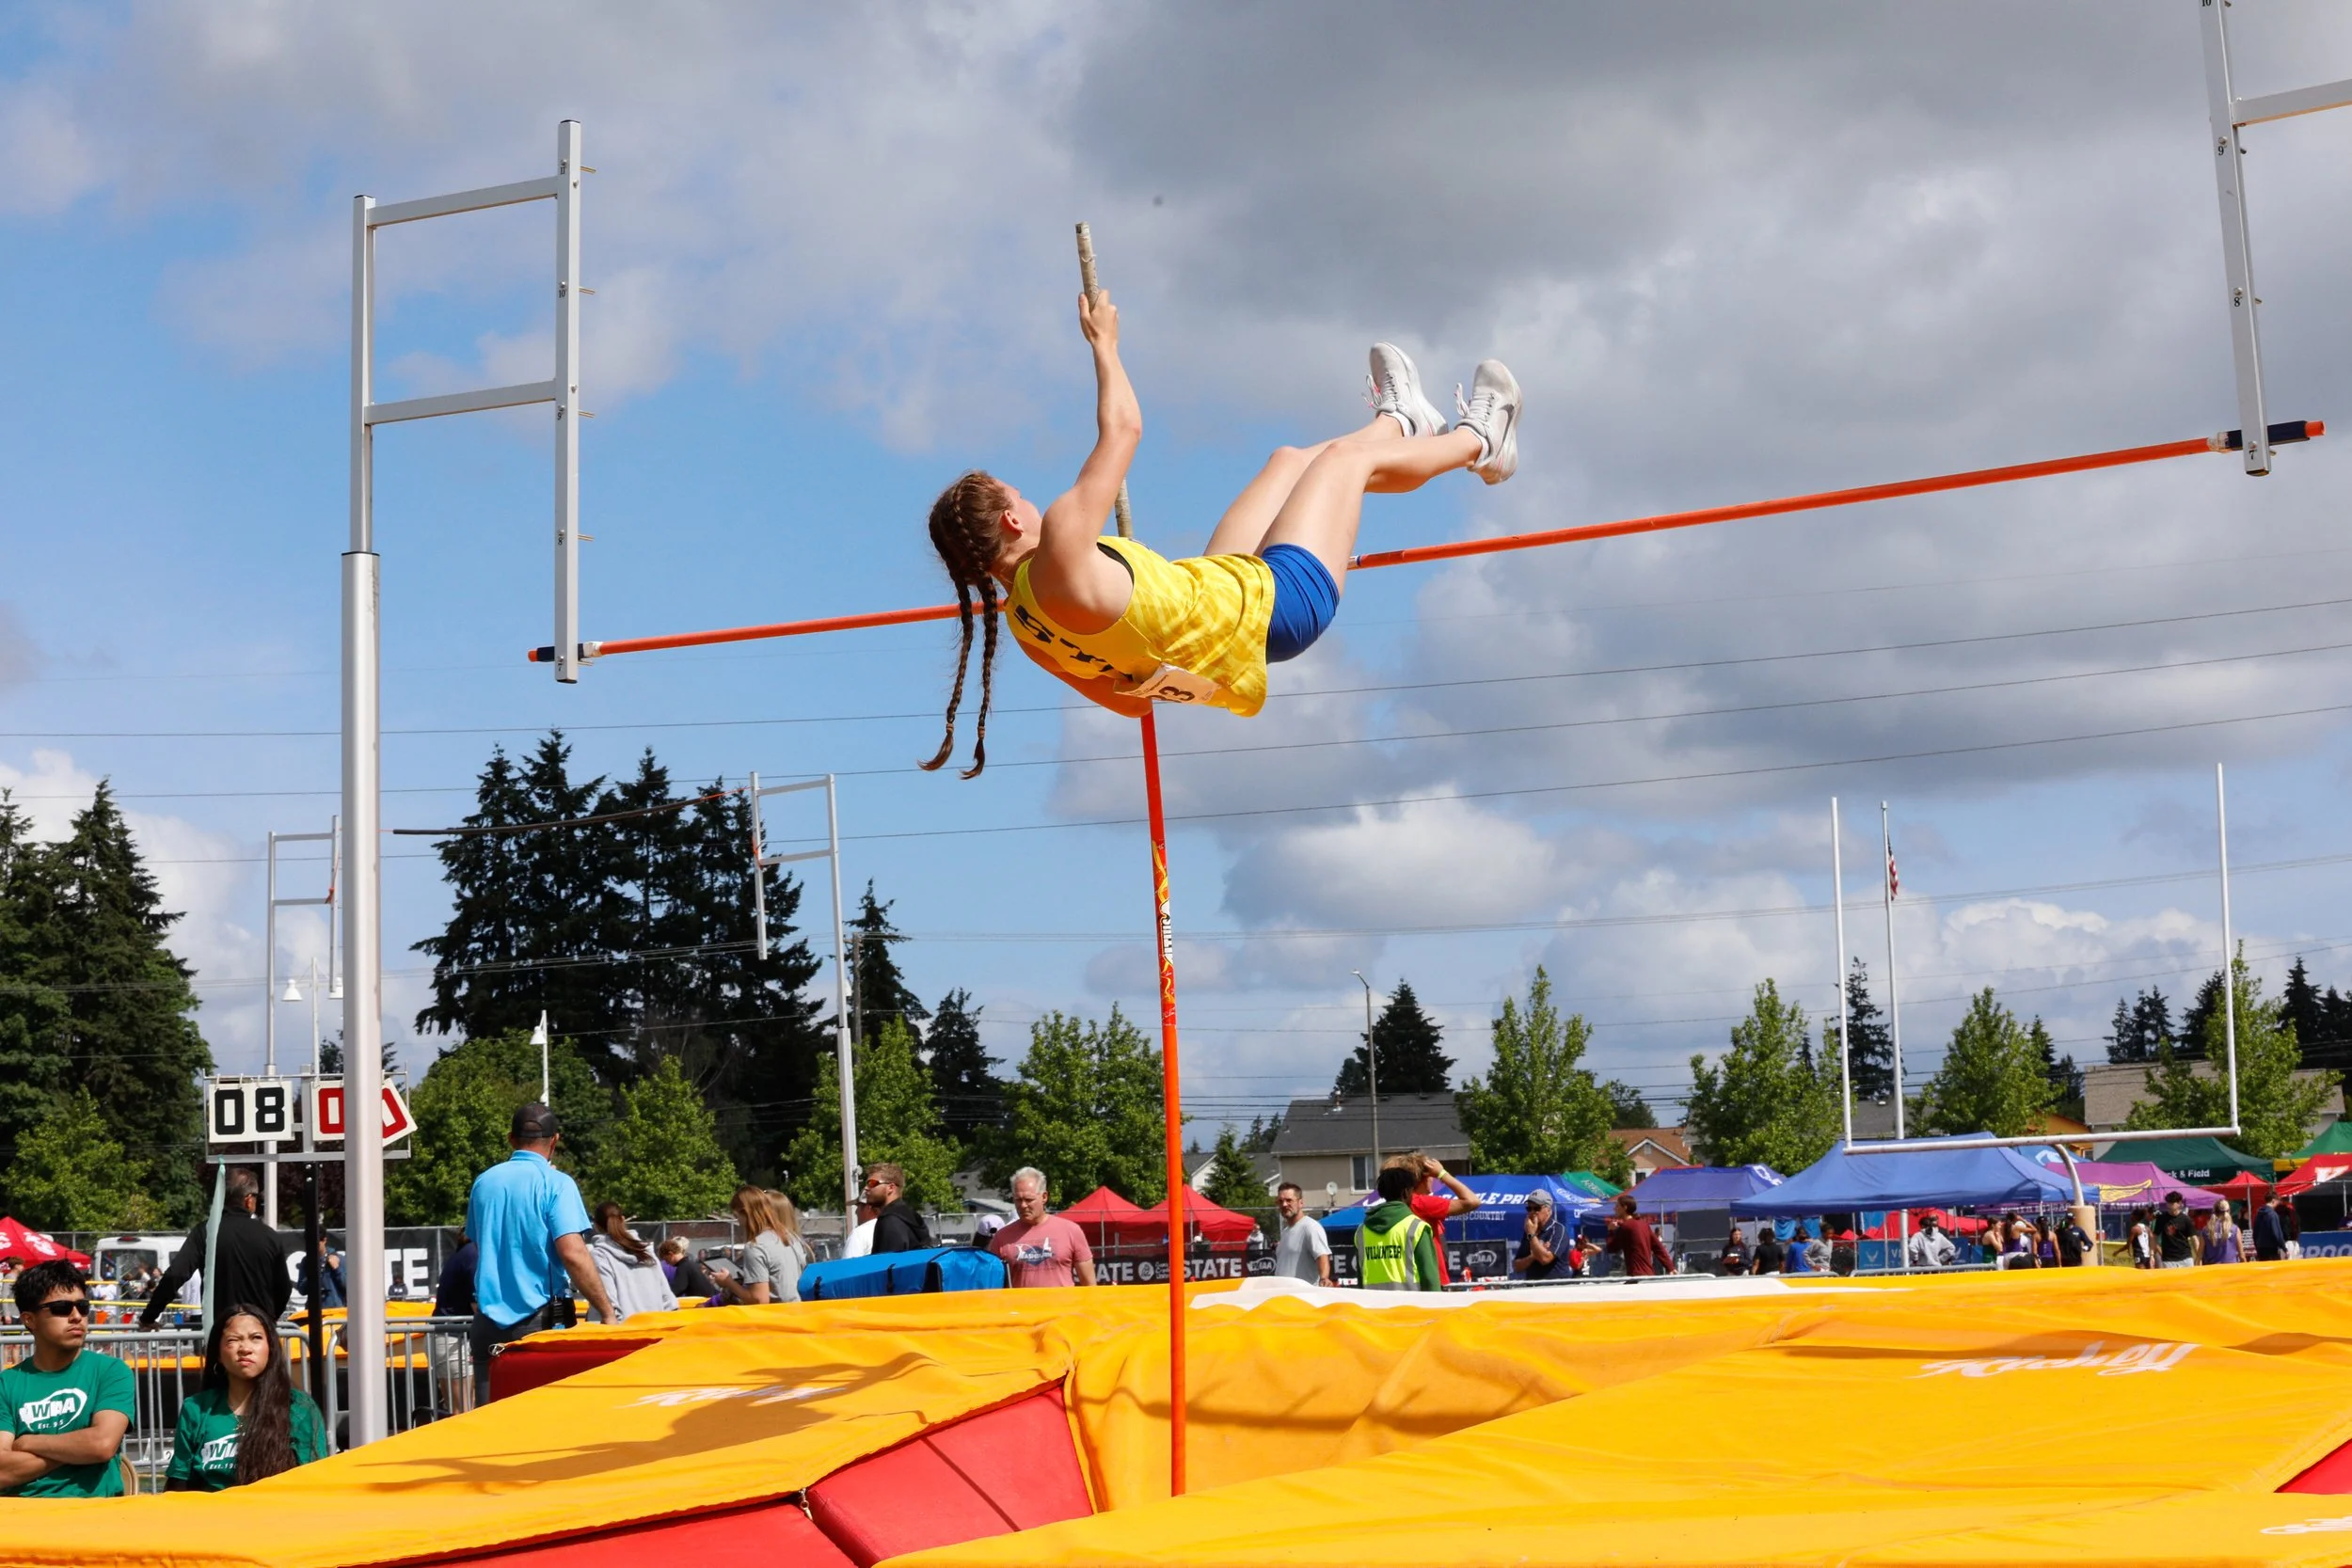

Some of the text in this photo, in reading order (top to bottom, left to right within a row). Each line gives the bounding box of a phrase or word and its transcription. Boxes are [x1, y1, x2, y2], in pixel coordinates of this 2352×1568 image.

[215, 1086, 285, 1135] 08
[2188, 1168, 2210, 1178] Field
[1470, 1211, 1506, 1221] COUNTRY
[1184, 1258, 1242, 1279] STATE
